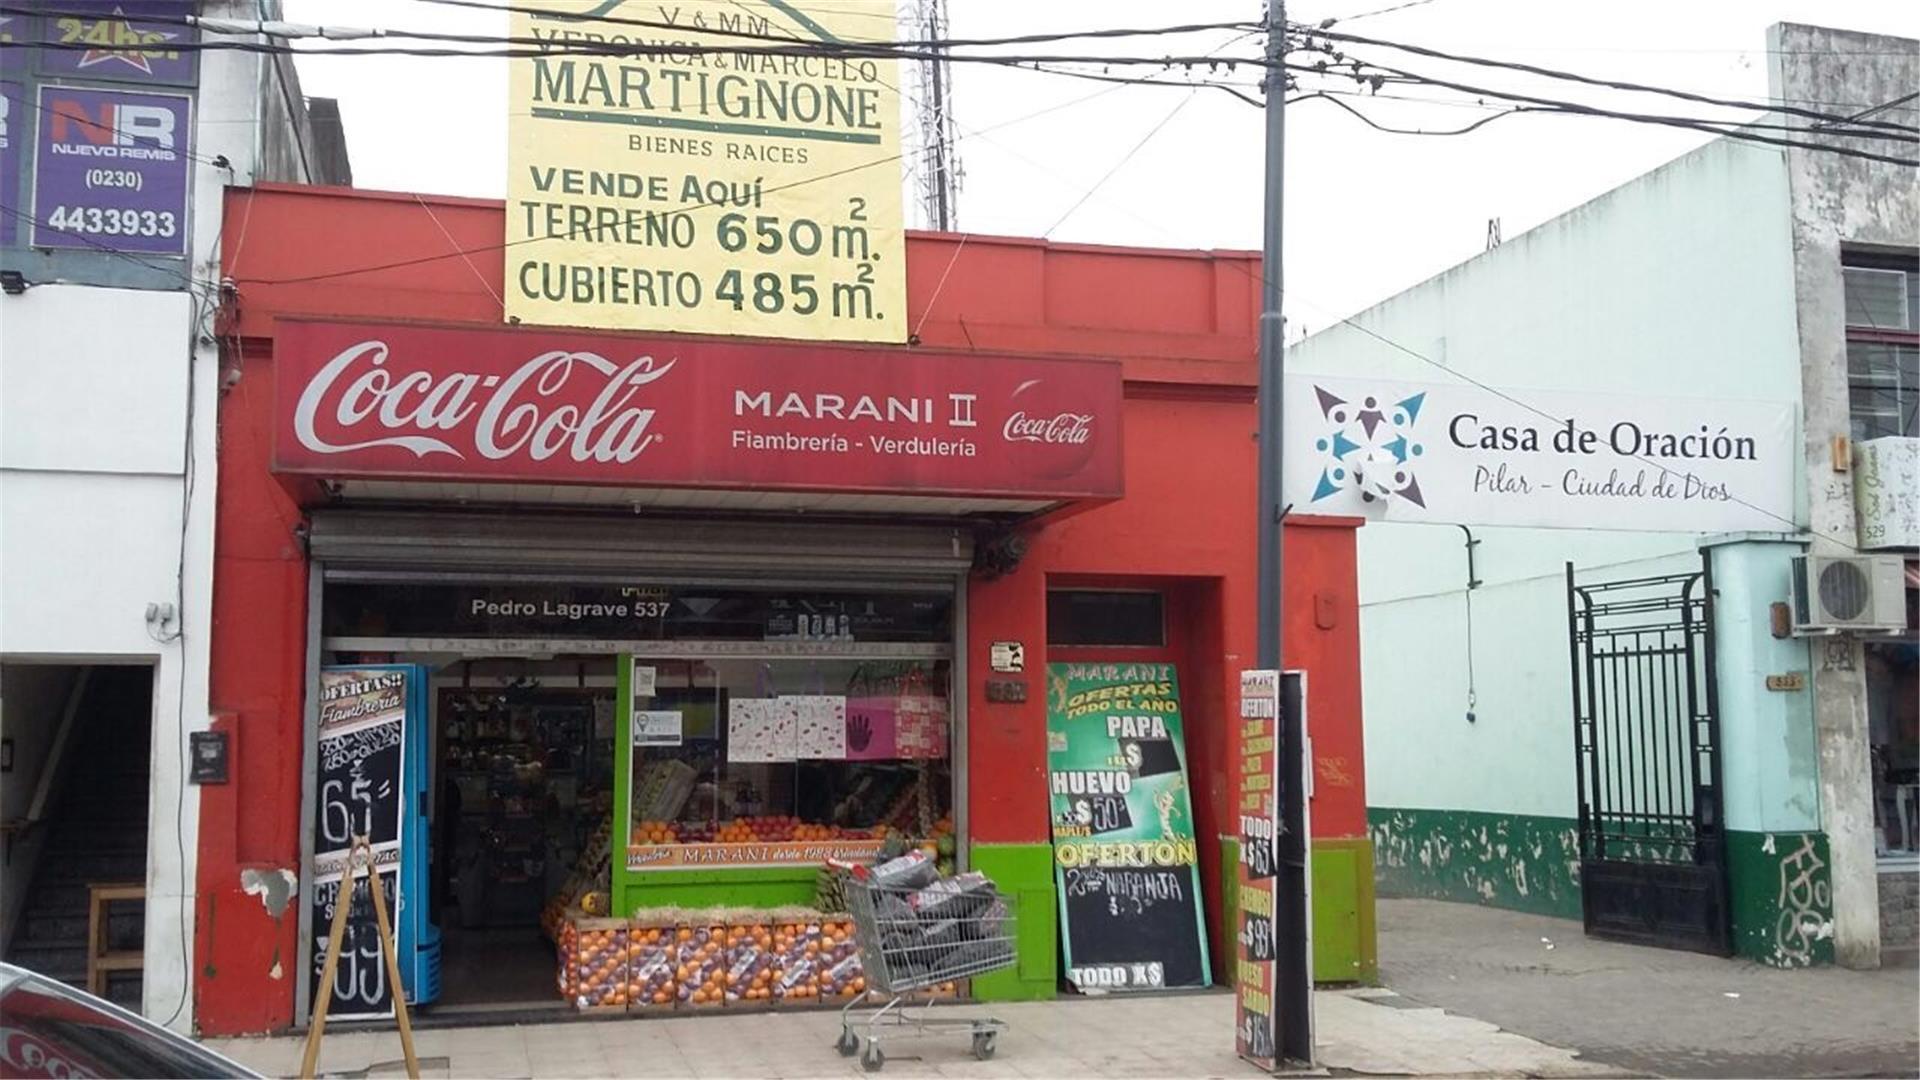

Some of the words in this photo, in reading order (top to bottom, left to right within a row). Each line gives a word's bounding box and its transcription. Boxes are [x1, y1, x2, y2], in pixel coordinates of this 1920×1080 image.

[658, 6, 680, 27] V
[692, 11, 709, 28] &
[718, 11, 770, 37] MM
[733, 49, 877, 84] MARCELO
[531, 58, 882, 130] MARTIGNONE
[52, 143, 118, 157] NUEVO
[120, 147, 176, 161] REMIS
[628, 134, 713, 157] BIENES
[726, 142, 809, 164] RAICES
[86, 169, 143, 191] (0230)
[529, 165, 668, 201] VENDE
[680, 175, 764, 208] AQUÍ
[48, 206, 176, 237] 4433933
[520, 201, 696, 249] TERRENO
[716, 213, 822, 256] 650
[519, 261, 701, 308] CUBIERTO
[715, 269, 819, 315] 485
[294, 340, 678, 464] Coca-Cola
[735, 390, 933, 424] MARANI
[948, 393, 977, 427] II
[1002, 411, 1095, 445] Coca-Cola
[1449, 414, 1540, 452] Casa
[1553, 419, 1597, 454] de
[1609, 422, 1757, 460] Oración
[732, 430, 849, 453] Fiambrería
[870, 435, 977, 457] Verdulería
[1474, 463, 1532, 495] Pilar
[1562, 468, 1647, 498] Ciudad
[1651, 470, 1677, 498] de
[1683, 473, 1732, 501] Dios
[471, 599, 536, 616] Pedro
[543, 600, 628, 620] Lagrave
[634, 602, 671, 618] 537
[1067, 663, 1170, 681] MARANI
[1067, 700, 1111, 719] TODO
[1115, 699, 1136, 710] EL
[1140, 697, 1178, 712] AÑO
[1068, 681, 1172, 708] OFERTAS
[1106, 716, 1168, 738] PAPA
[1125, 743, 1142, 767] $
[1052, 771, 1132, 794] HUEVO
[1239, 815, 1272, 840] TODO
[683, 847, 768, 863] MARANI
[1056, 841, 1197, 868] OFERTON
[1071, 966, 1128, 986] TODO
